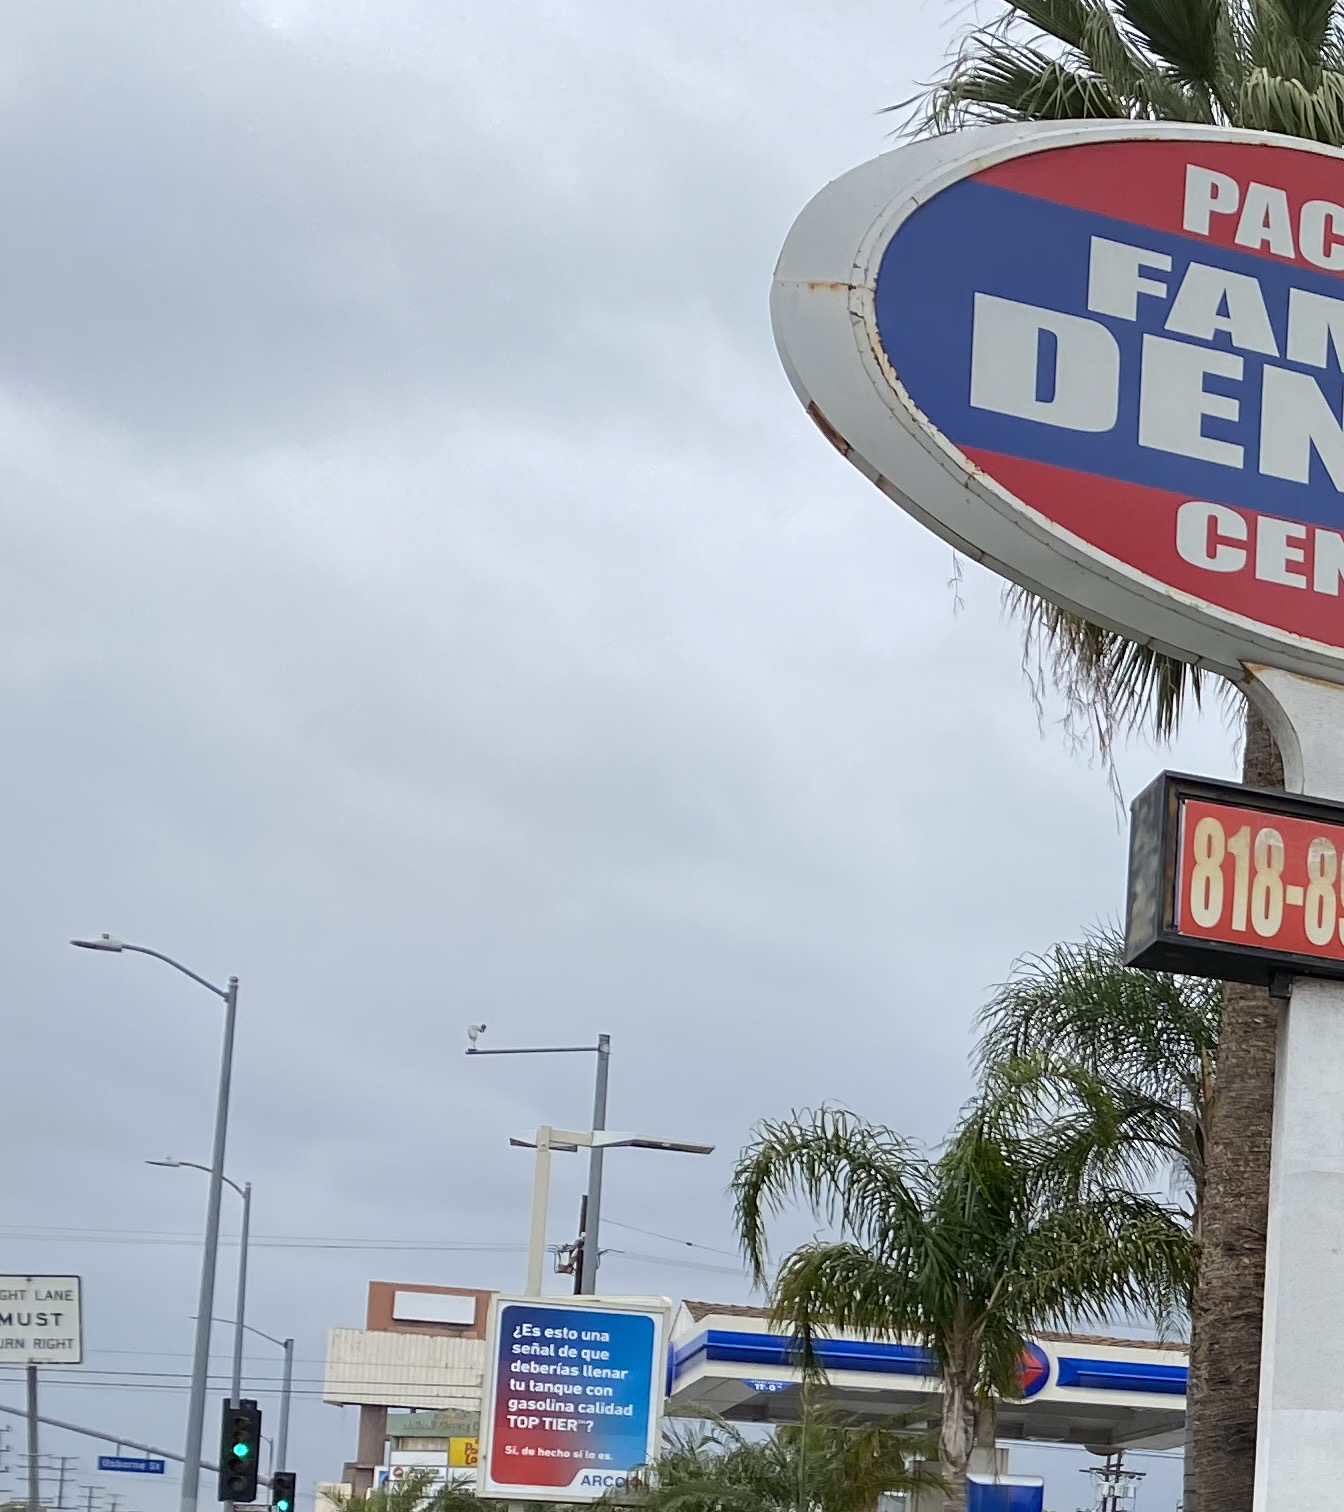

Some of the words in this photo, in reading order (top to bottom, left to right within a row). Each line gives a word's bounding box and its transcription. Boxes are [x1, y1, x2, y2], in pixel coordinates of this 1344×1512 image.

[0, 1289, 27, 1301] GHT
[34, 1289, 74, 1301] LANE
[0, 1312, 63, 1326] MUST
[512, 1323, 541, 1338] ¿Es
[544, 1327, 578, 1340] esto
[581, 1331, 610, 1342] una
[33, 1338, 75, 1349] RIGHT
[511, 1343, 555, 1356] señal
[558, 1345, 578, 1358] de
[581, 1348, 610, 1361] que
[510, 1360, 579, 1376] deberías
[583, 1365, 629, 1380] llenar
[509, 1378, 525, 1391] tu
[529, 1380, 582, 1396] tanque
[586, 1386, 613, 1397] con
[508, 1398, 574, 1413] gasolina
[578, 1402, 633, 1416] calidad
[506, 1415, 540, 1430] TOP
[521, 1446, 535, 1456] de
[537, 1447, 570, 1458] hecho
[585, 1450, 595, 1460] lo
[581, 1475, 626, 1488] ARCO
